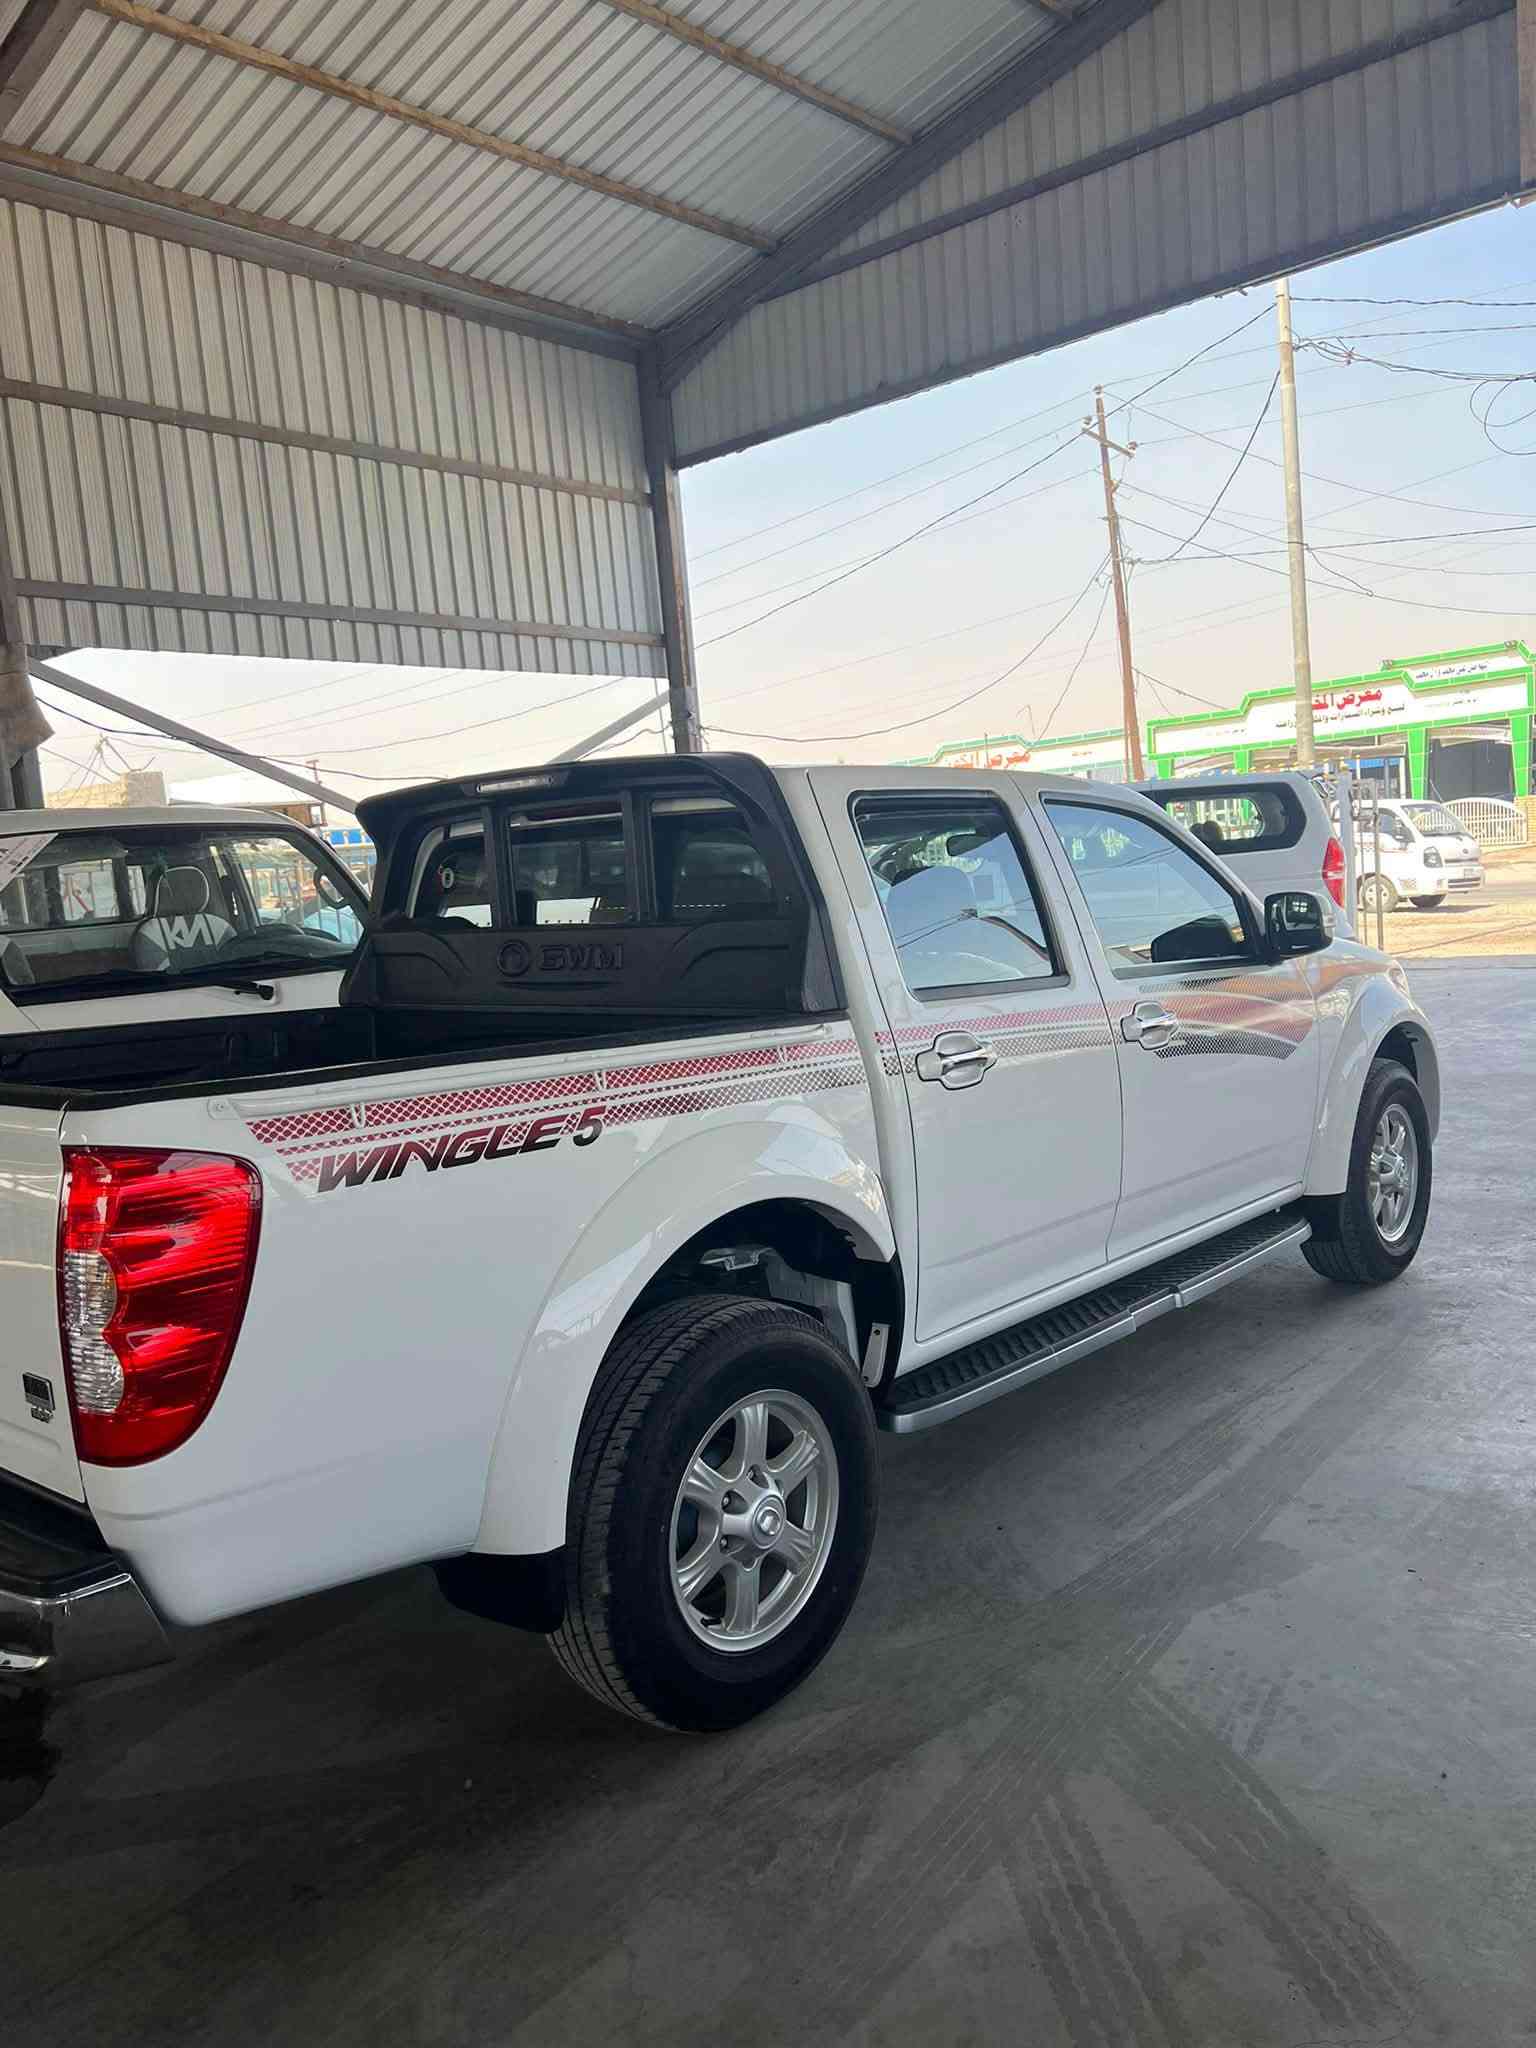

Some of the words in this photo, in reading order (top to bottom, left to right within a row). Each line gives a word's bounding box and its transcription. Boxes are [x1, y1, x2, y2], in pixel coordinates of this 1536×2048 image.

[1336, 687, 1383, 710] معرض
[318, 1114, 568, 1192] WINGLE
[573, 1105, 606, 1147] 5
